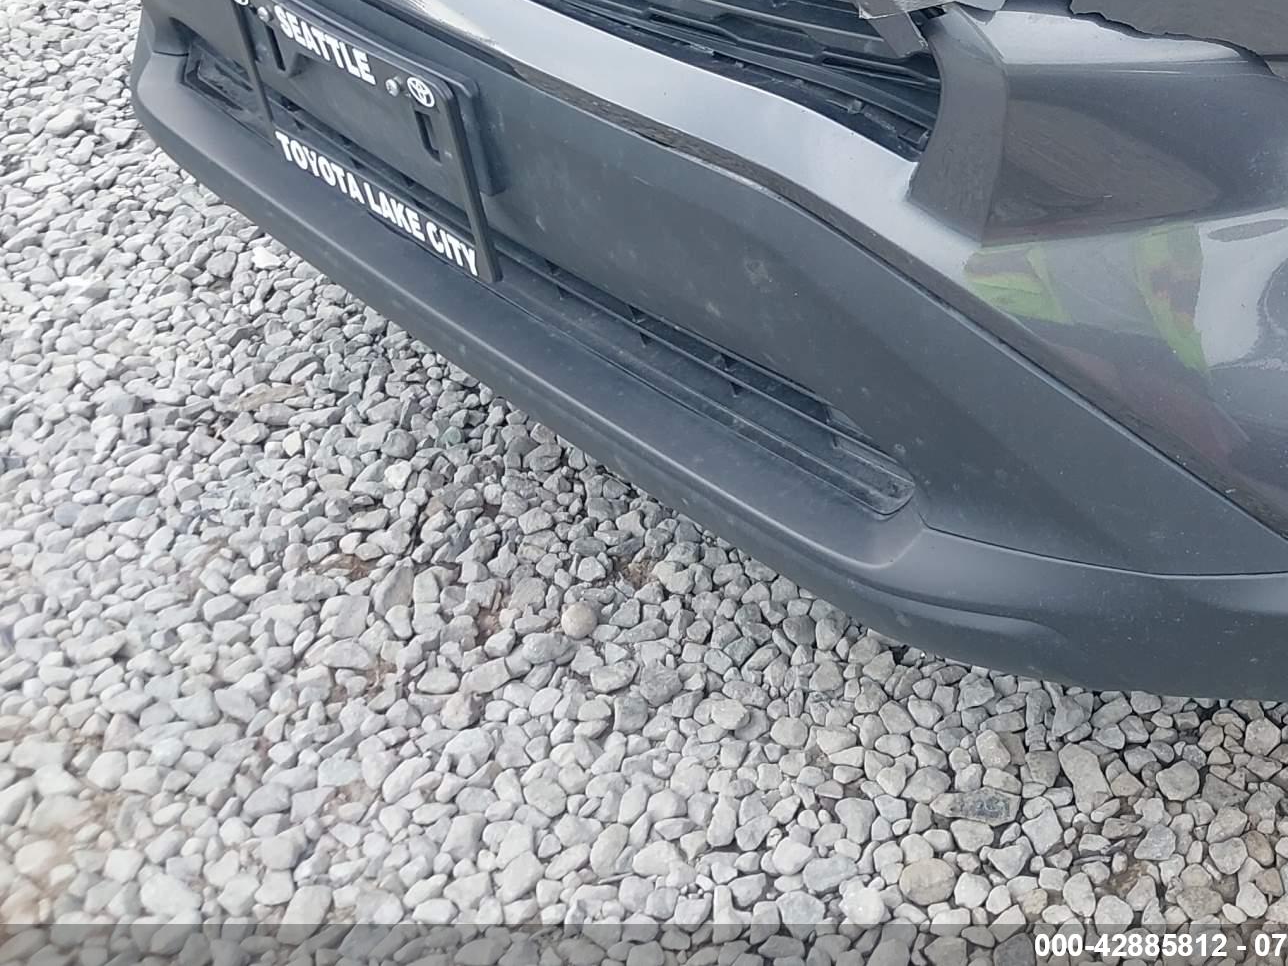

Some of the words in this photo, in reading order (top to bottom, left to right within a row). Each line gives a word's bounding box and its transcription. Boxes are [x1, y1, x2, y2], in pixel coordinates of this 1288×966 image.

[274, 5, 376, 85] SEATTLE
[275, 131, 366, 205] TOYOTA
[364, 182, 425, 242] LAKE
[426, 221, 478, 276] CITY
